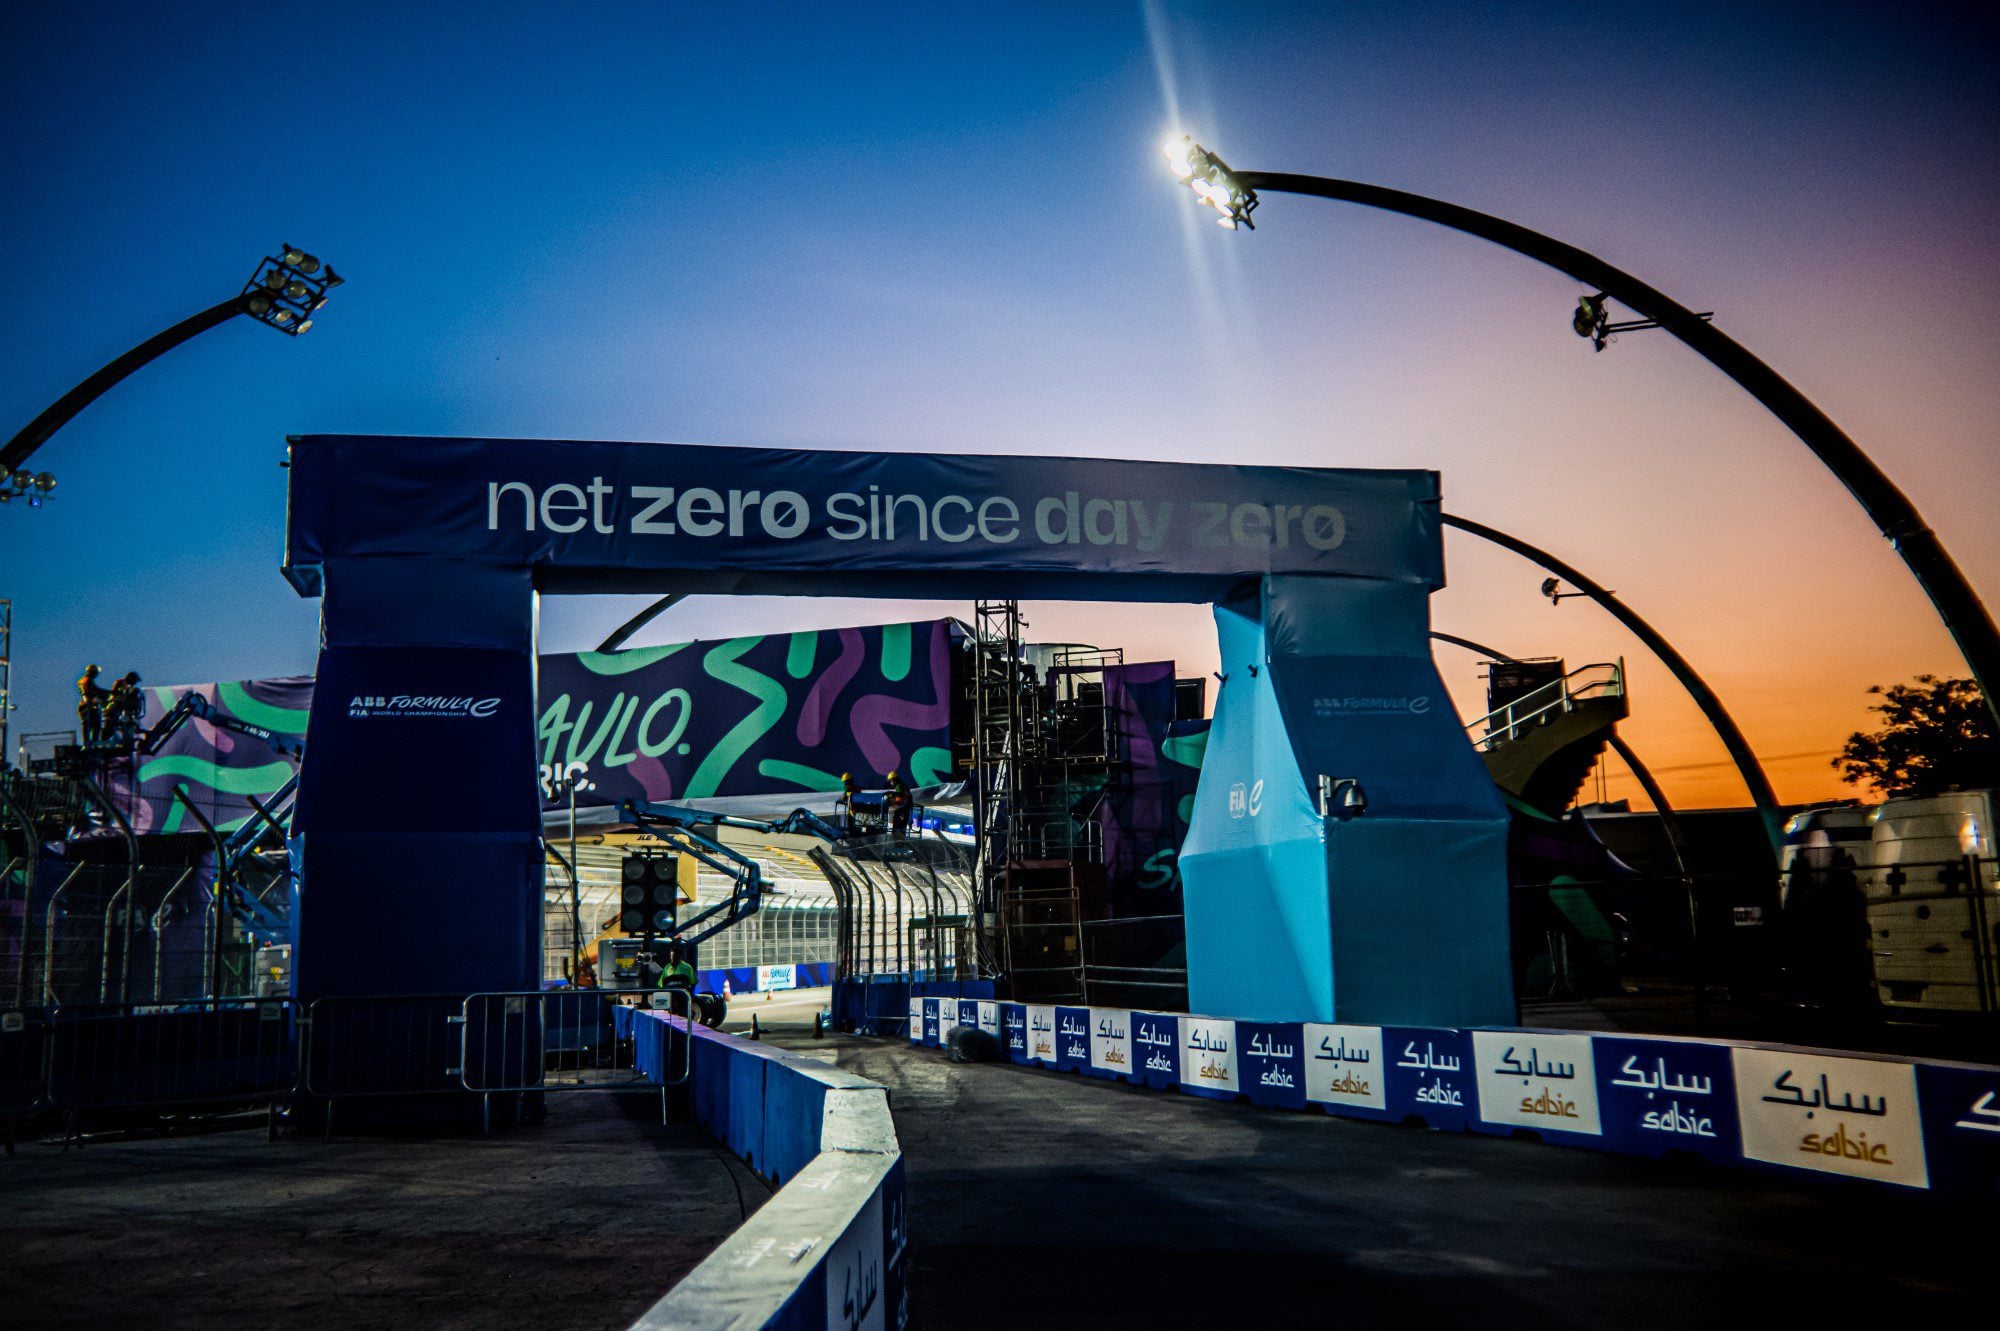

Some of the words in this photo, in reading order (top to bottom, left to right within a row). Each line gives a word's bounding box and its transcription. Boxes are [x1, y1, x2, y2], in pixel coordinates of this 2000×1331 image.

[488, 475, 615, 535] net
[630, 484, 811, 540] zero
[825, 484, 1021, 543] since
[1034, 490, 1175, 552] day
[350, 696, 387, 707] ABB
[387, 695, 473, 709] FORMULA
[350, 709, 369, 718] FIA
[1145, 1050, 1173, 1072] sabic
[1200, 1058, 1229, 1081] sabic
[1260, 1063, 1295, 1088] sabic
[1330, 1069, 1372, 1096] sabic
[1415, 1077, 1465, 1107] sabic
[1519, 1087, 1580, 1119] sabic
[1641, 1100, 1718, 1138] sabic
[1799, 1122, 1894, 1166] sabic
